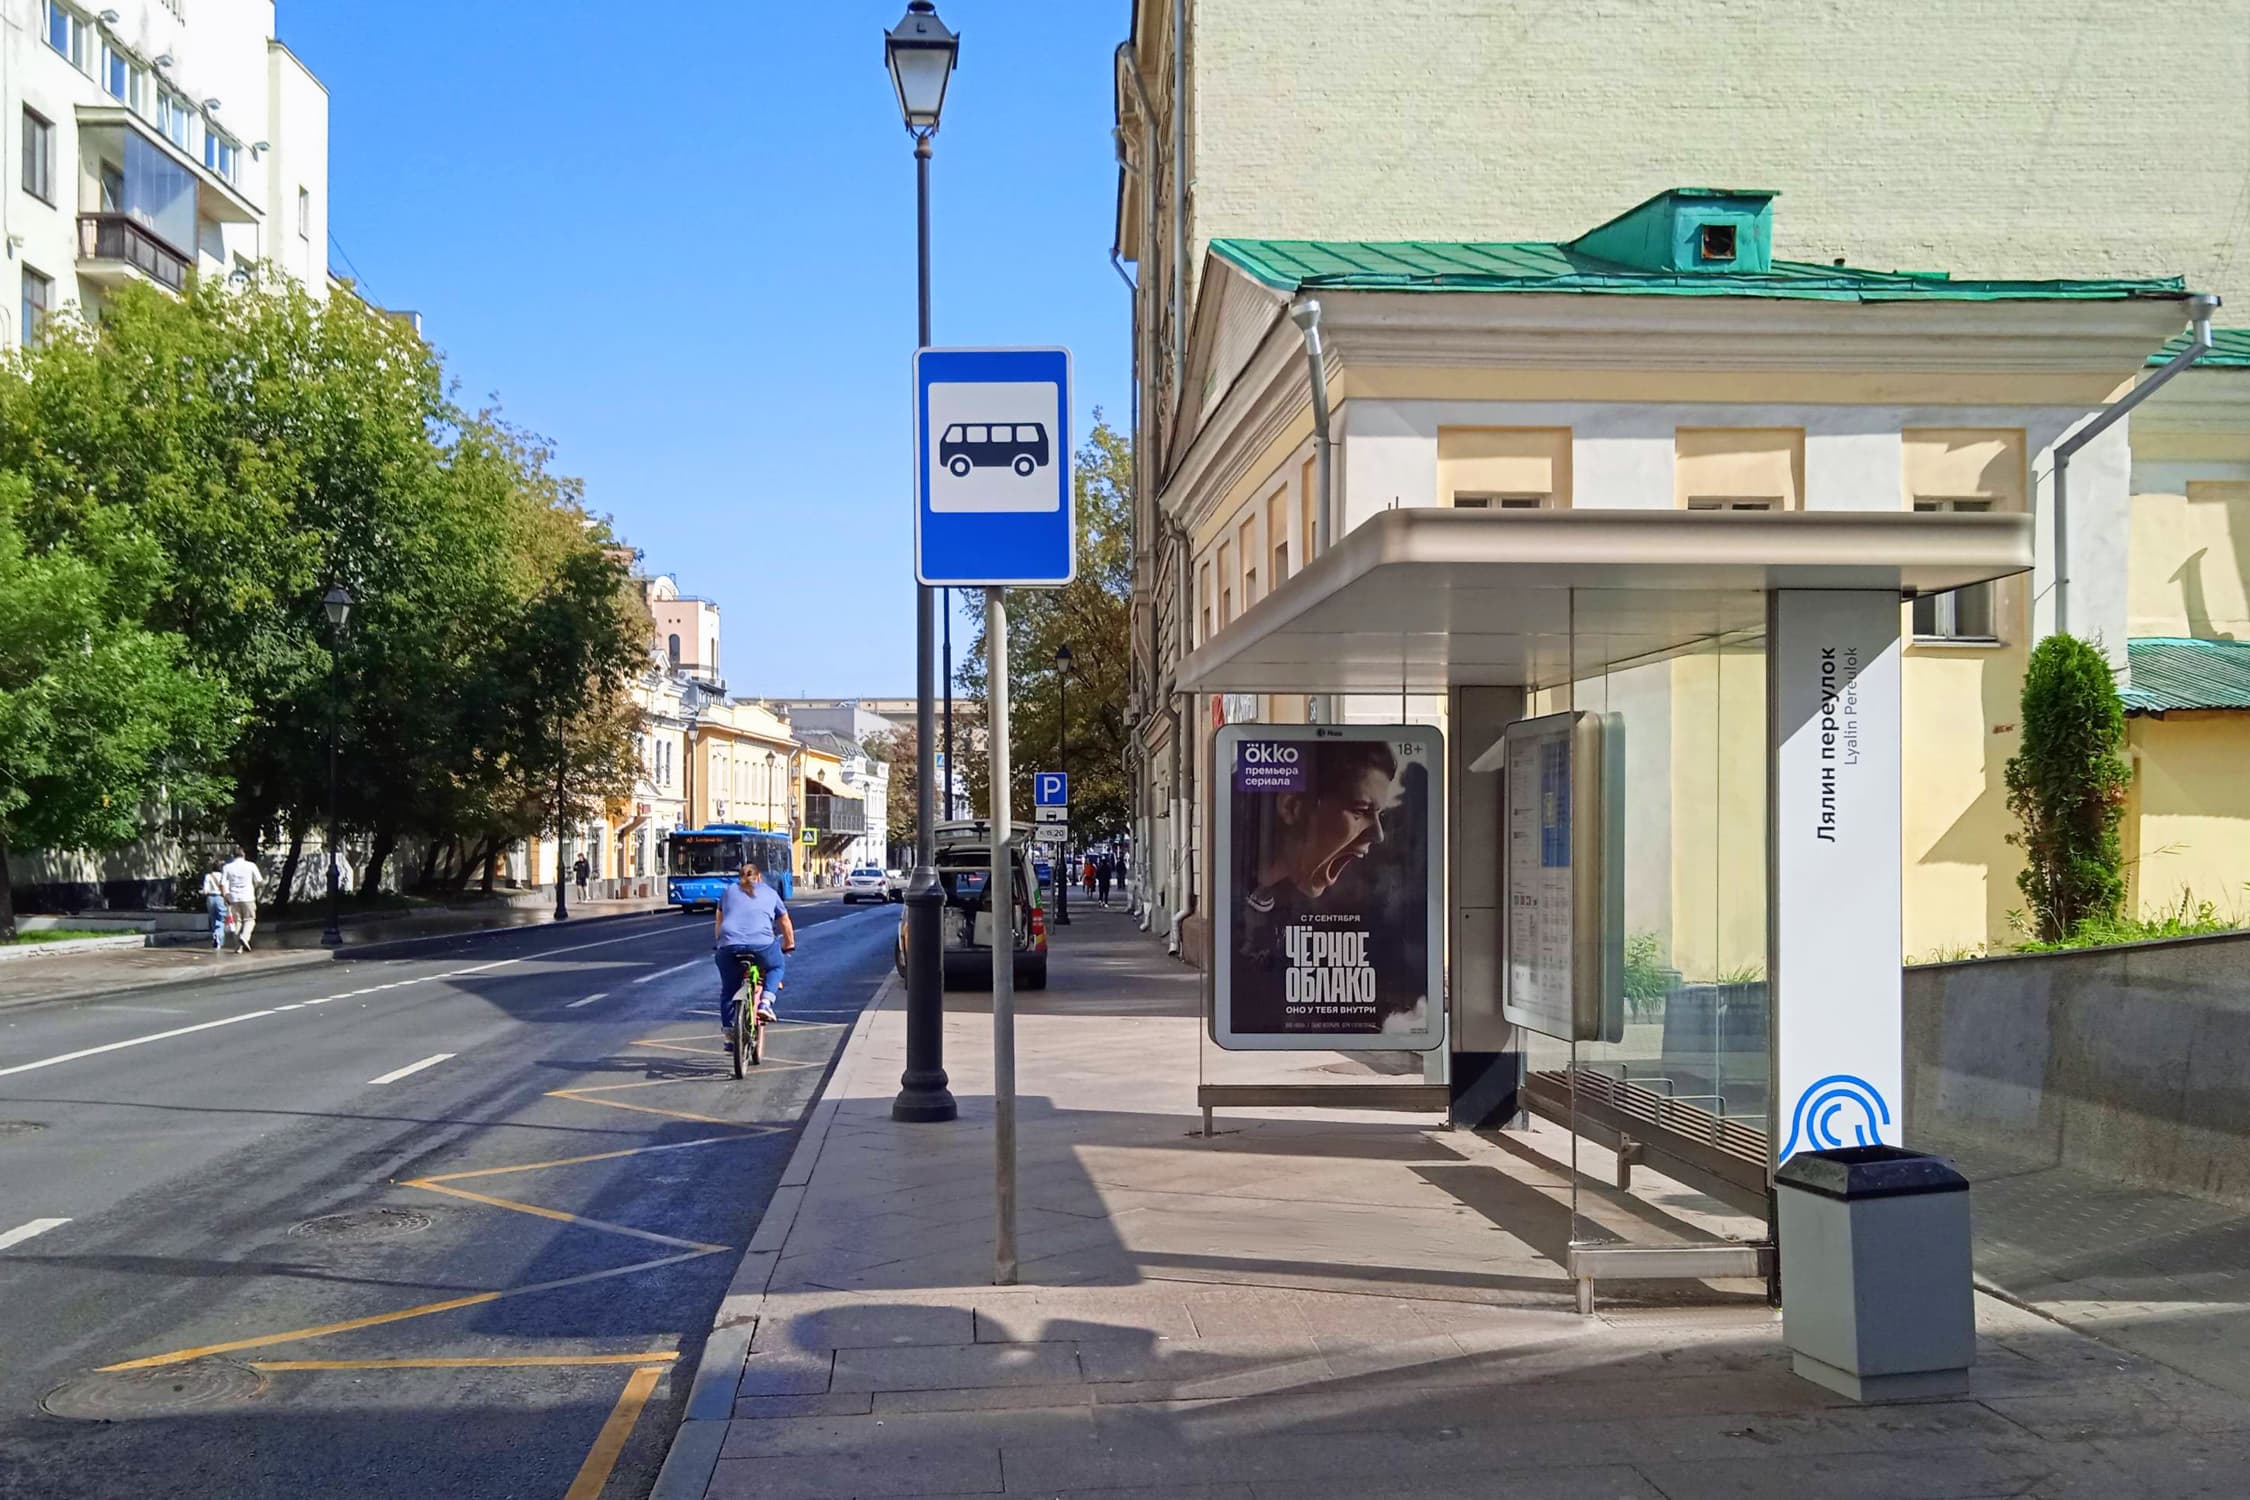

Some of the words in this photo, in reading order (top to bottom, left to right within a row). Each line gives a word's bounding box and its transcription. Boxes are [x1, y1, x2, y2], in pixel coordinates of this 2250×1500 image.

[1843, 647, 1857, 715] Pereulok
[1821, 647, 1839, 759] переулок
[1398, 743, 1422, 756] 18+
[1843, 720, 1859, 765] Lyalin
[1245, 767, 1299, 776] премьера
[1245, 777, 1290, 787] сериала
[1817, 767, 1835, 843] Лялин
[1300, 914, 1307, 922] С
[1308, 914, 1314, 922] 7
[1314, 914, 1361, 922] СЕНТЯБРЯ
[1285, 925, 1370, 967] ЧЁРНОЕ
[1285, 967, 1376, 1003] ОБЛАКО
[1285, 1006, 1306, 1014] ОНО
[1306, 1006, 1314, 1014] У
[1315, 1006, 1338, 1014] ТЕБЯ
[1340, 1006, 1377, 1014] ВНУТРИ
